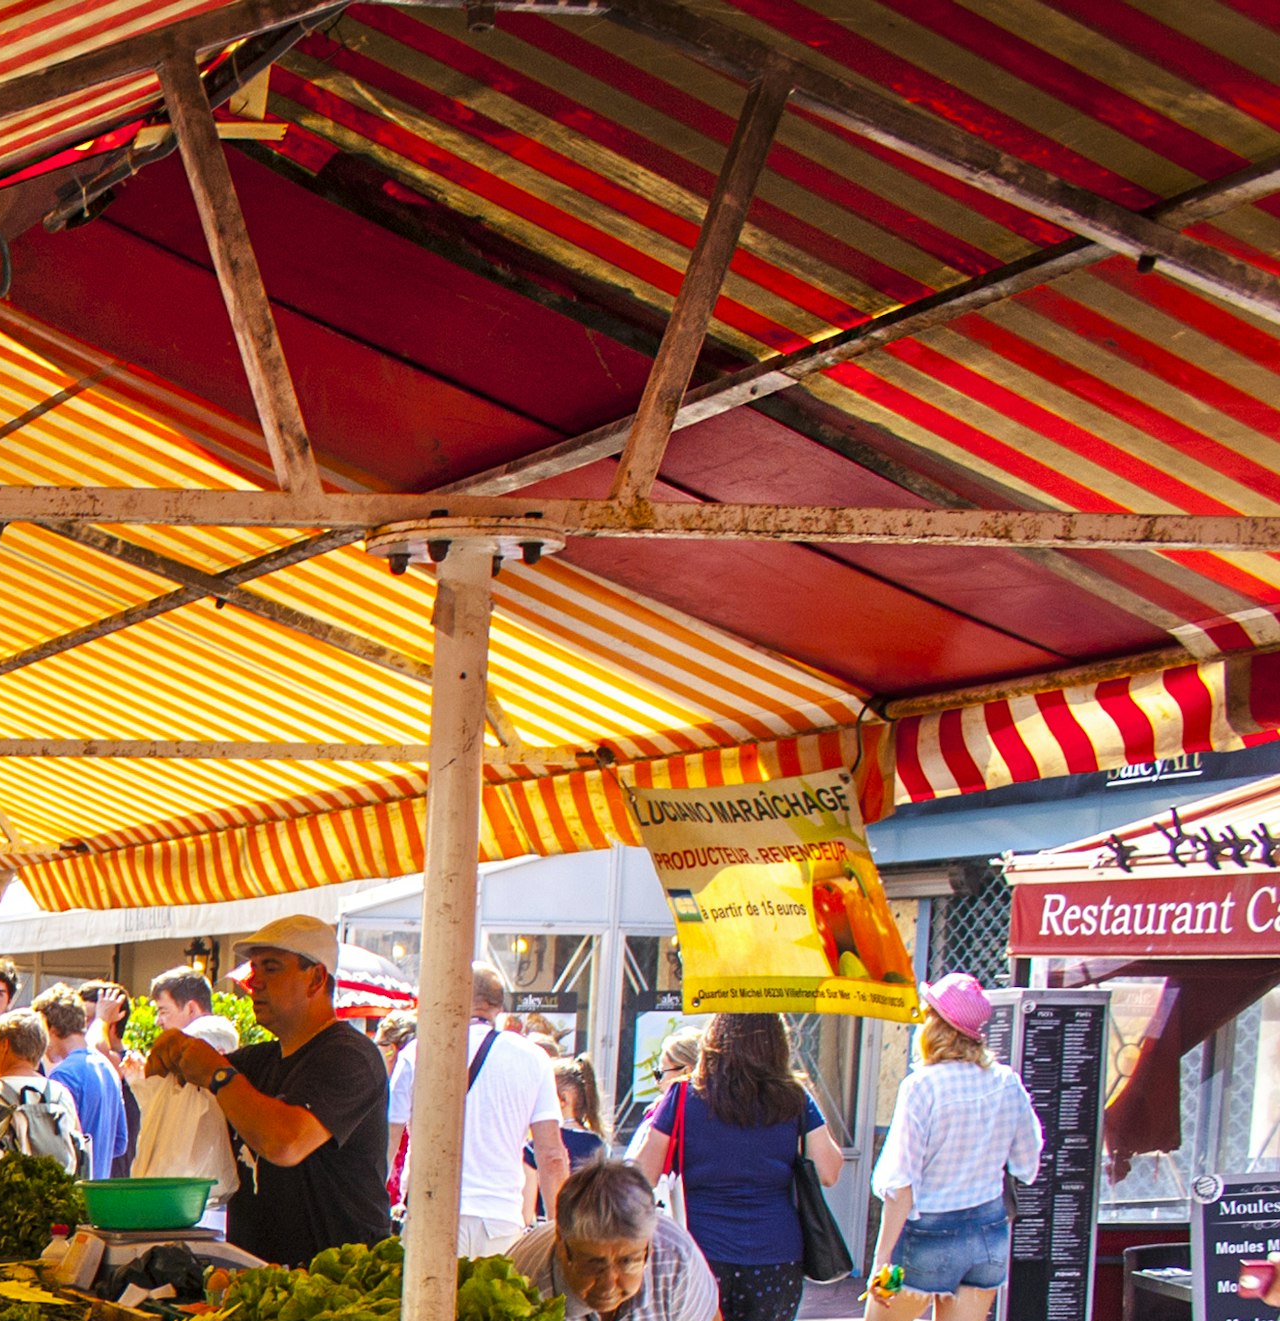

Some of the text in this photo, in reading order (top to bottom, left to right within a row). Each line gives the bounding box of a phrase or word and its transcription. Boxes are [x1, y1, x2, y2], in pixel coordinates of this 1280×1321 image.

[633, 786, 851, 826] LUCIANO MARAÎCHAGE
[652, 846, 750, 871] PRODUCTEUR
[759, 841, 849, 864] REVENDEUR
[701, 900, 807, 923] à partir de 15 euros
[1038, 891, 1236, 936] Restaurant
[1218, 1198, 1280, 1216] Moules
[1215, 1240, 1265, 1255] Moules
